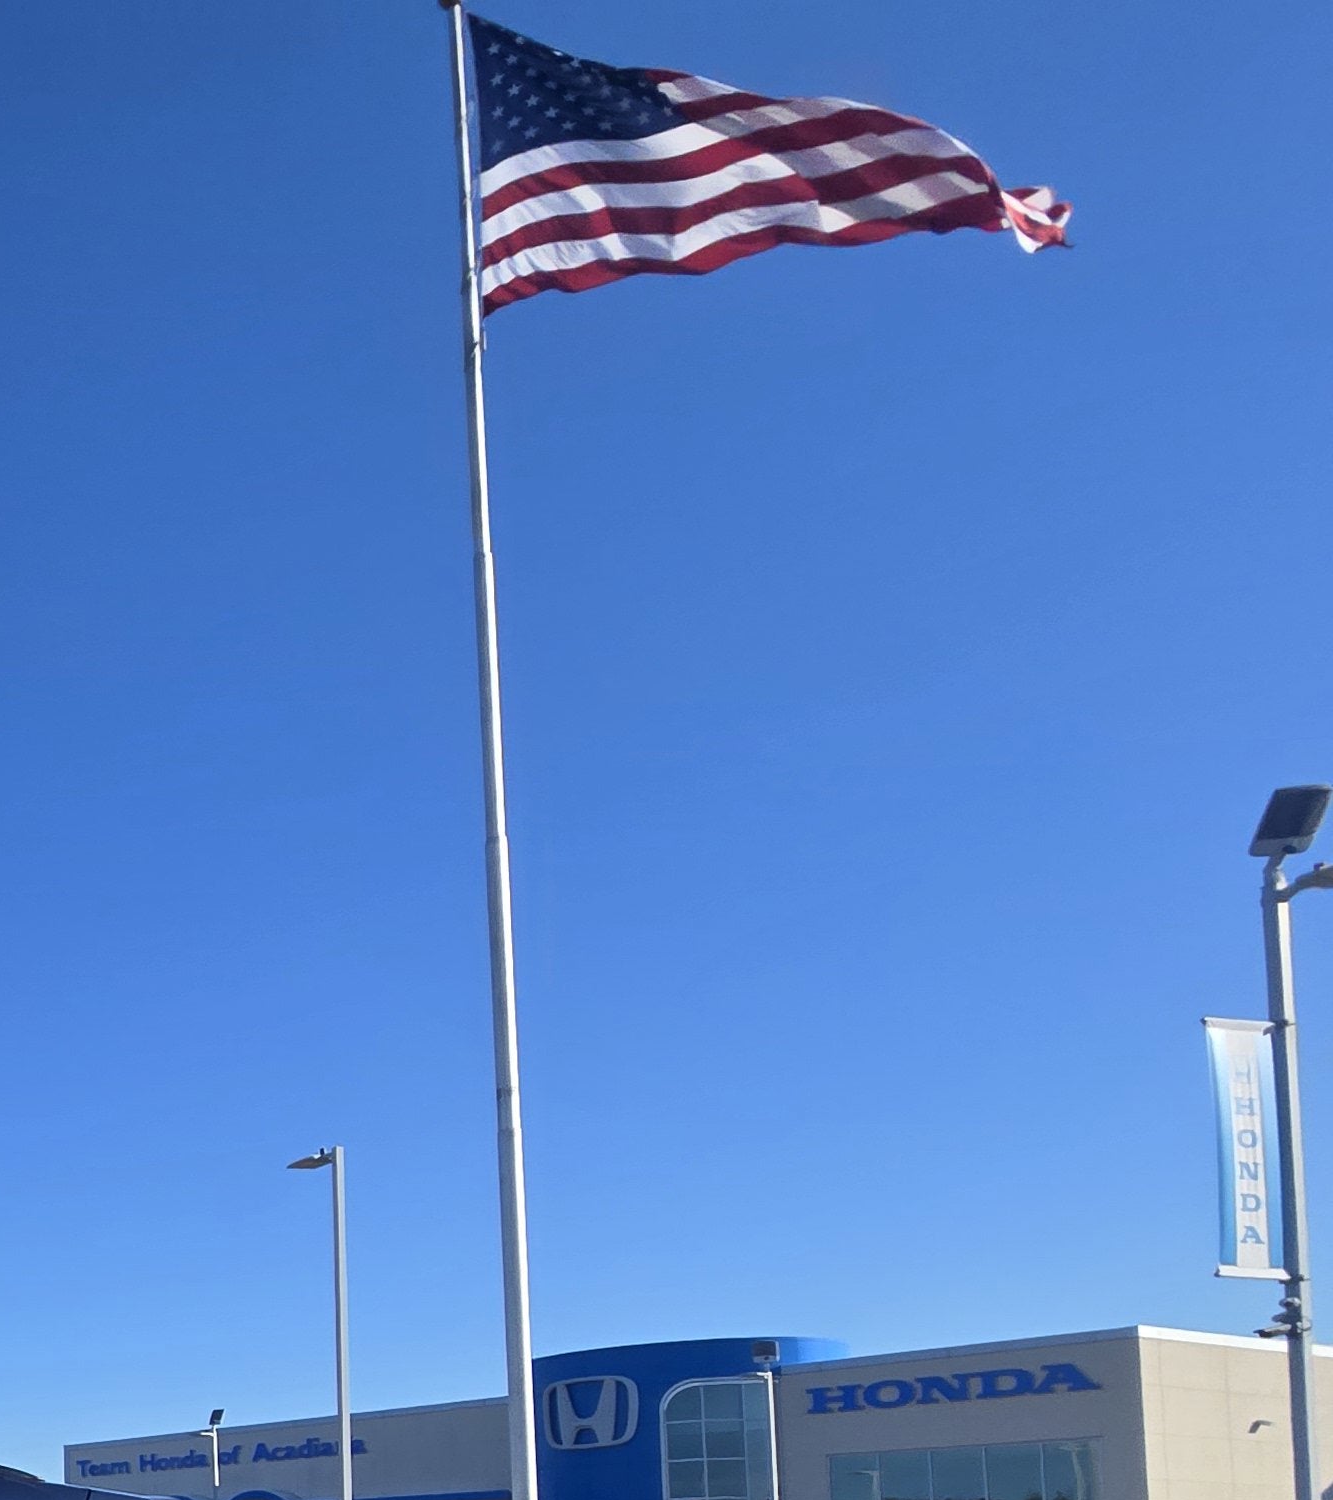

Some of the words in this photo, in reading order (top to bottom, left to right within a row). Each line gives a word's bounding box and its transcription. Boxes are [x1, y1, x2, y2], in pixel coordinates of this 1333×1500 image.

[1234, 1096, 1265, 1245] HONDA
[805, 1363, 1102, 1414] HONDA
[76, 1459, 132, 1478] Team
[139, 1449, 210, 1472] Honda
[218, 1445, 241, 1465] of
